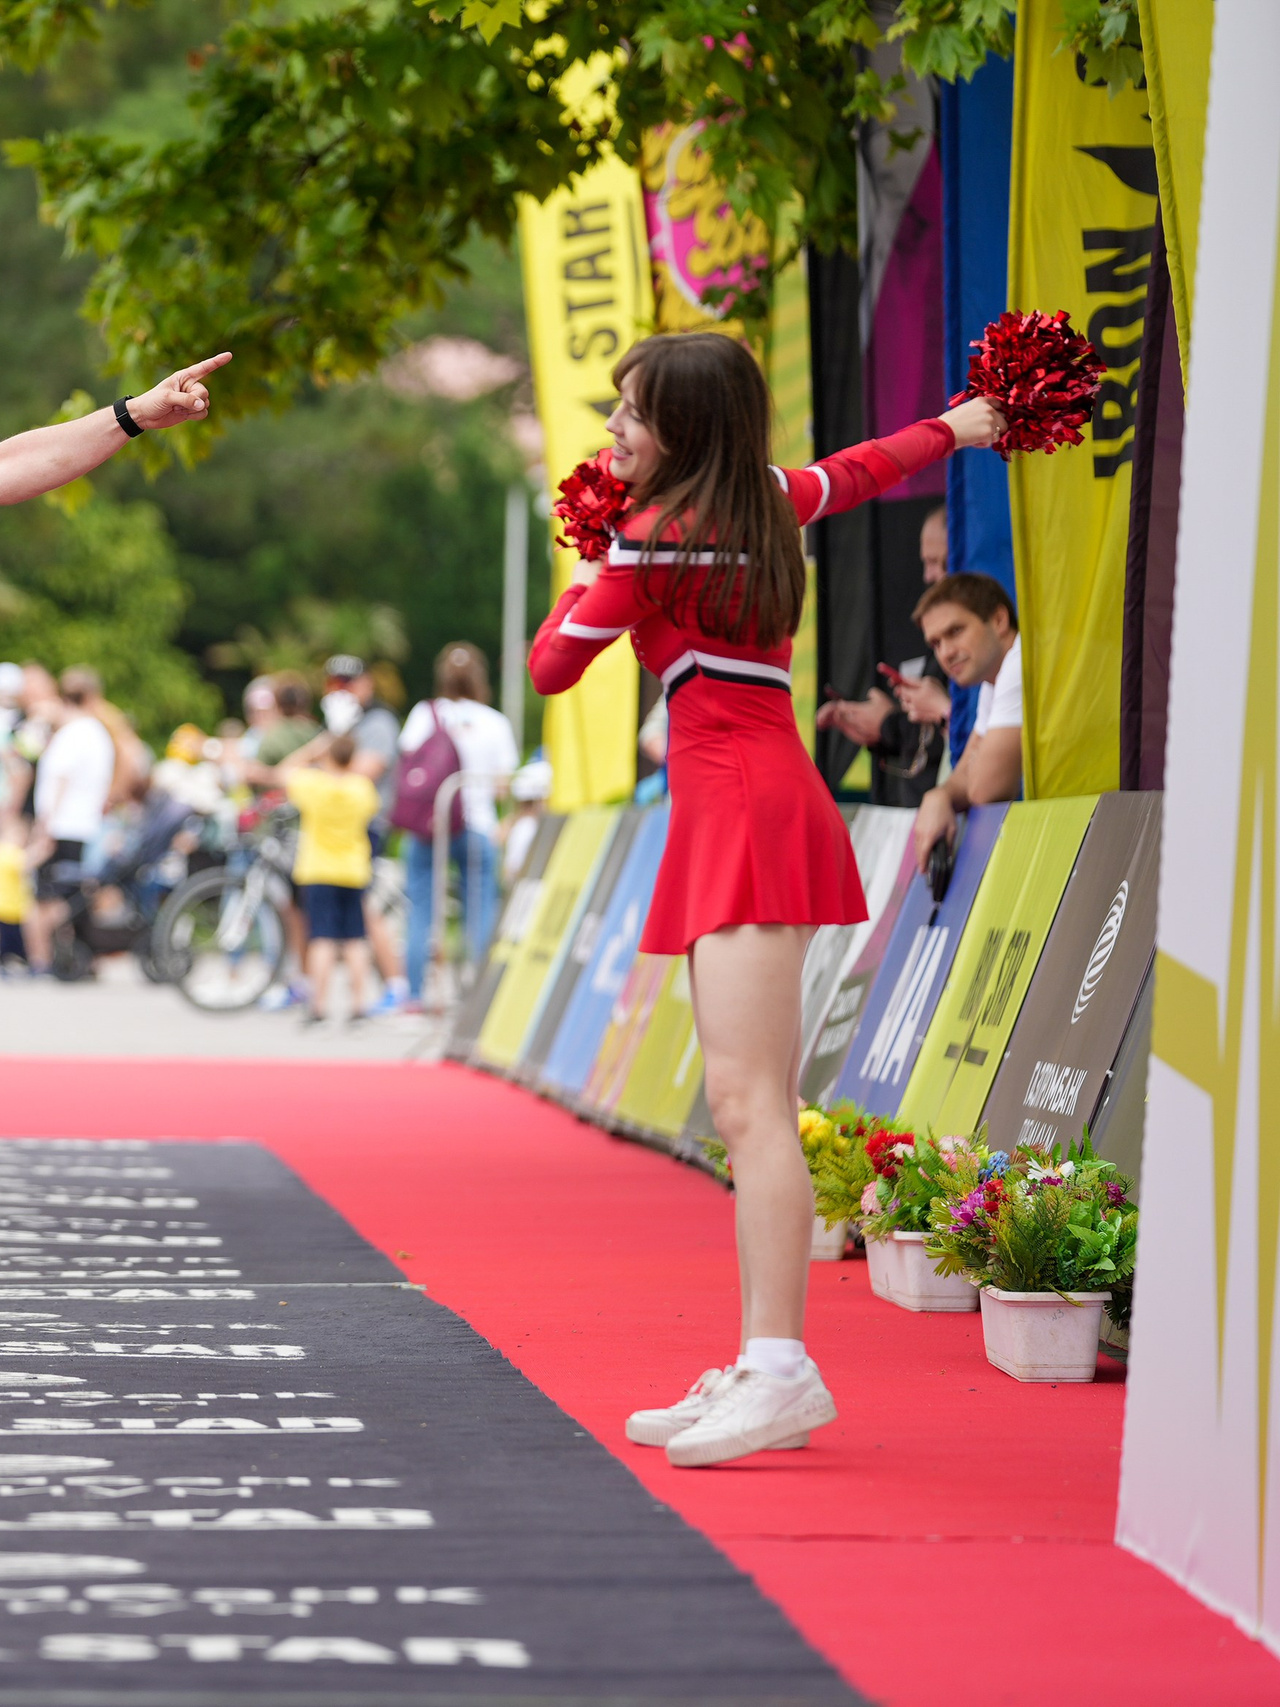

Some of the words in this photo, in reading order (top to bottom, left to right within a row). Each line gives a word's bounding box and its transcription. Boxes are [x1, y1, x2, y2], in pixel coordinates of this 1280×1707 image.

[565, 201, 618, 362] STAR
[12, 1416, 364, 1431] STAR
[24, 1507, 436, 1530] STAR
[38, 1632, 531, 1669] STAR
